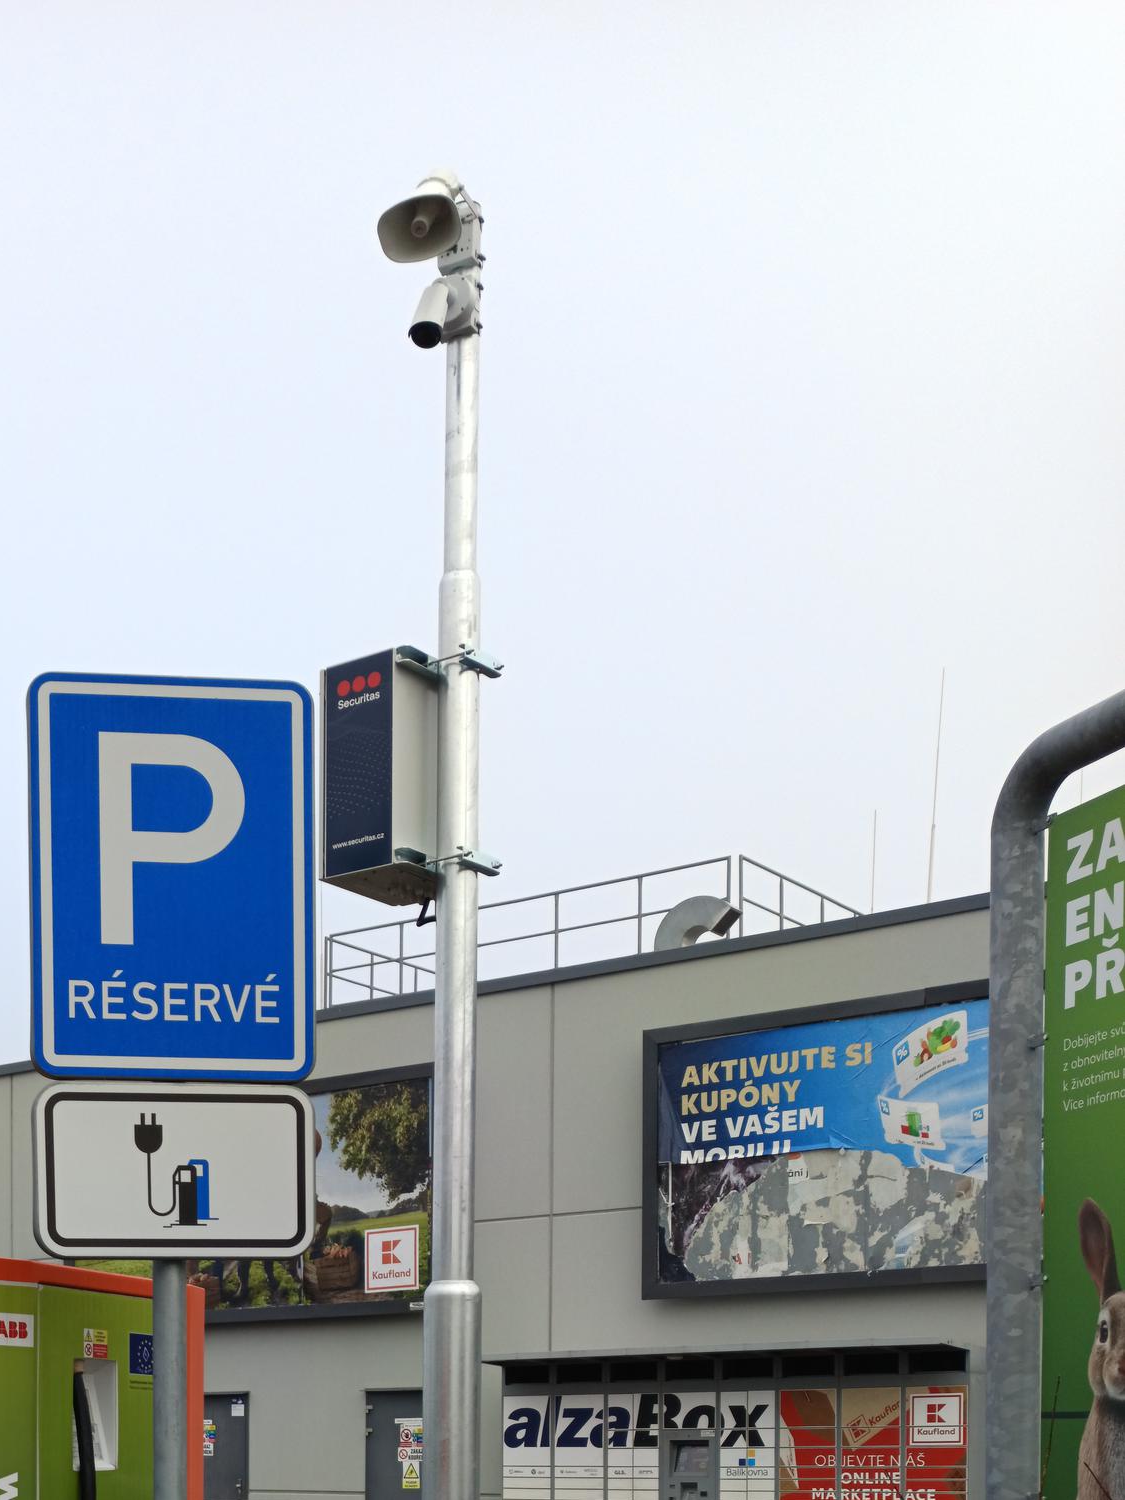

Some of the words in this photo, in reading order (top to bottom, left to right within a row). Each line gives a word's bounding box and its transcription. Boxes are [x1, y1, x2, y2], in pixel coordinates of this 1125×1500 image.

[337, 691, 380, 710] Securitas
[98, 731, 246, 945] P
[332, 832, 385, 850] www.securitas.cz
[1066, 817, 1125, 885] ZA
[1066, 881, 1125, 948] EN
[1064, 933, 1125, 1010] PŘ
[67, 969, 280, 1025] RÉSERVÉ
[1063, 1031, 1108, 1051] Dobíjejte
[681, 1045, 836, 1088] AKTIVUJTE
[845, 1041, 873, 1066] SI
[1063, 1062, 1069, 1072] z
[1062, 1080, 1069, 1092] k
[1071, 1068, 1120, 1090] životnímu
[681, 1079, 802, 1116] KUPÓNY
[1063, 1099, 1084, 1112] Více
[681, 1119, 717, 1144] VE
[725, 1105, 824, 1139] VAŠEM
[372, 1268, 412, 1280] Kaufland
[503, 1393, 769, 1448] alzaBox
[868, 1400, 900, 1427] Kaufla
[917, 1428, 956, 1436] Kaufland
[814, 1455, 884, 1467] OBJEVTE
[890, 1453, 926, 1467] NÁŠ
[841, 1471, 901, 1485] ONLINE
